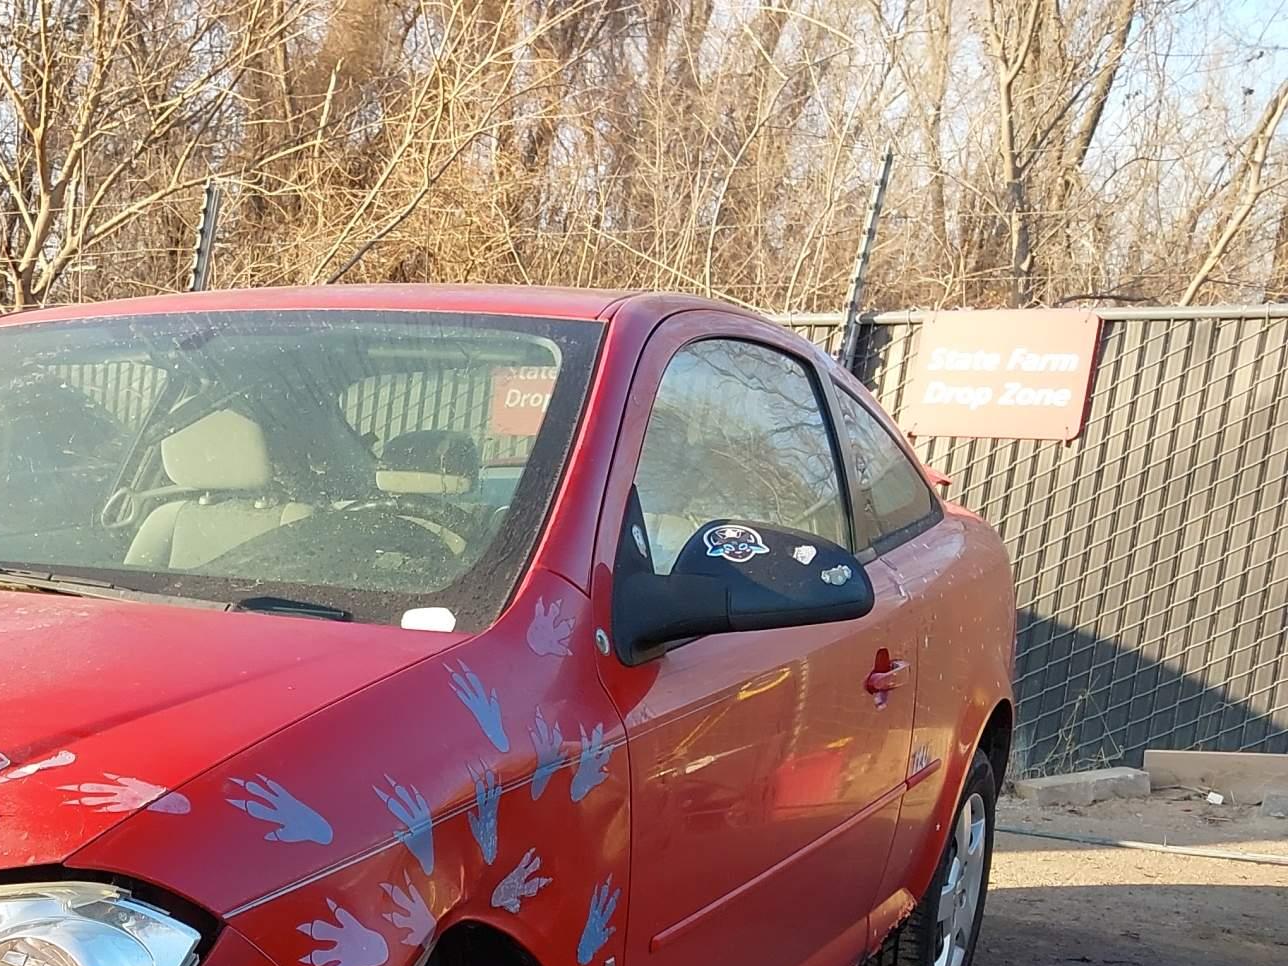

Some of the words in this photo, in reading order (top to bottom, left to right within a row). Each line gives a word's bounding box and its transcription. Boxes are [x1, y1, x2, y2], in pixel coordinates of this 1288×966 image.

[927, 346, 1002, 372] State
[1006, 346, 1080, 373] Farm
[922, 381, 993, 411] Drop
[997, 382, 1072, 408] Zone
